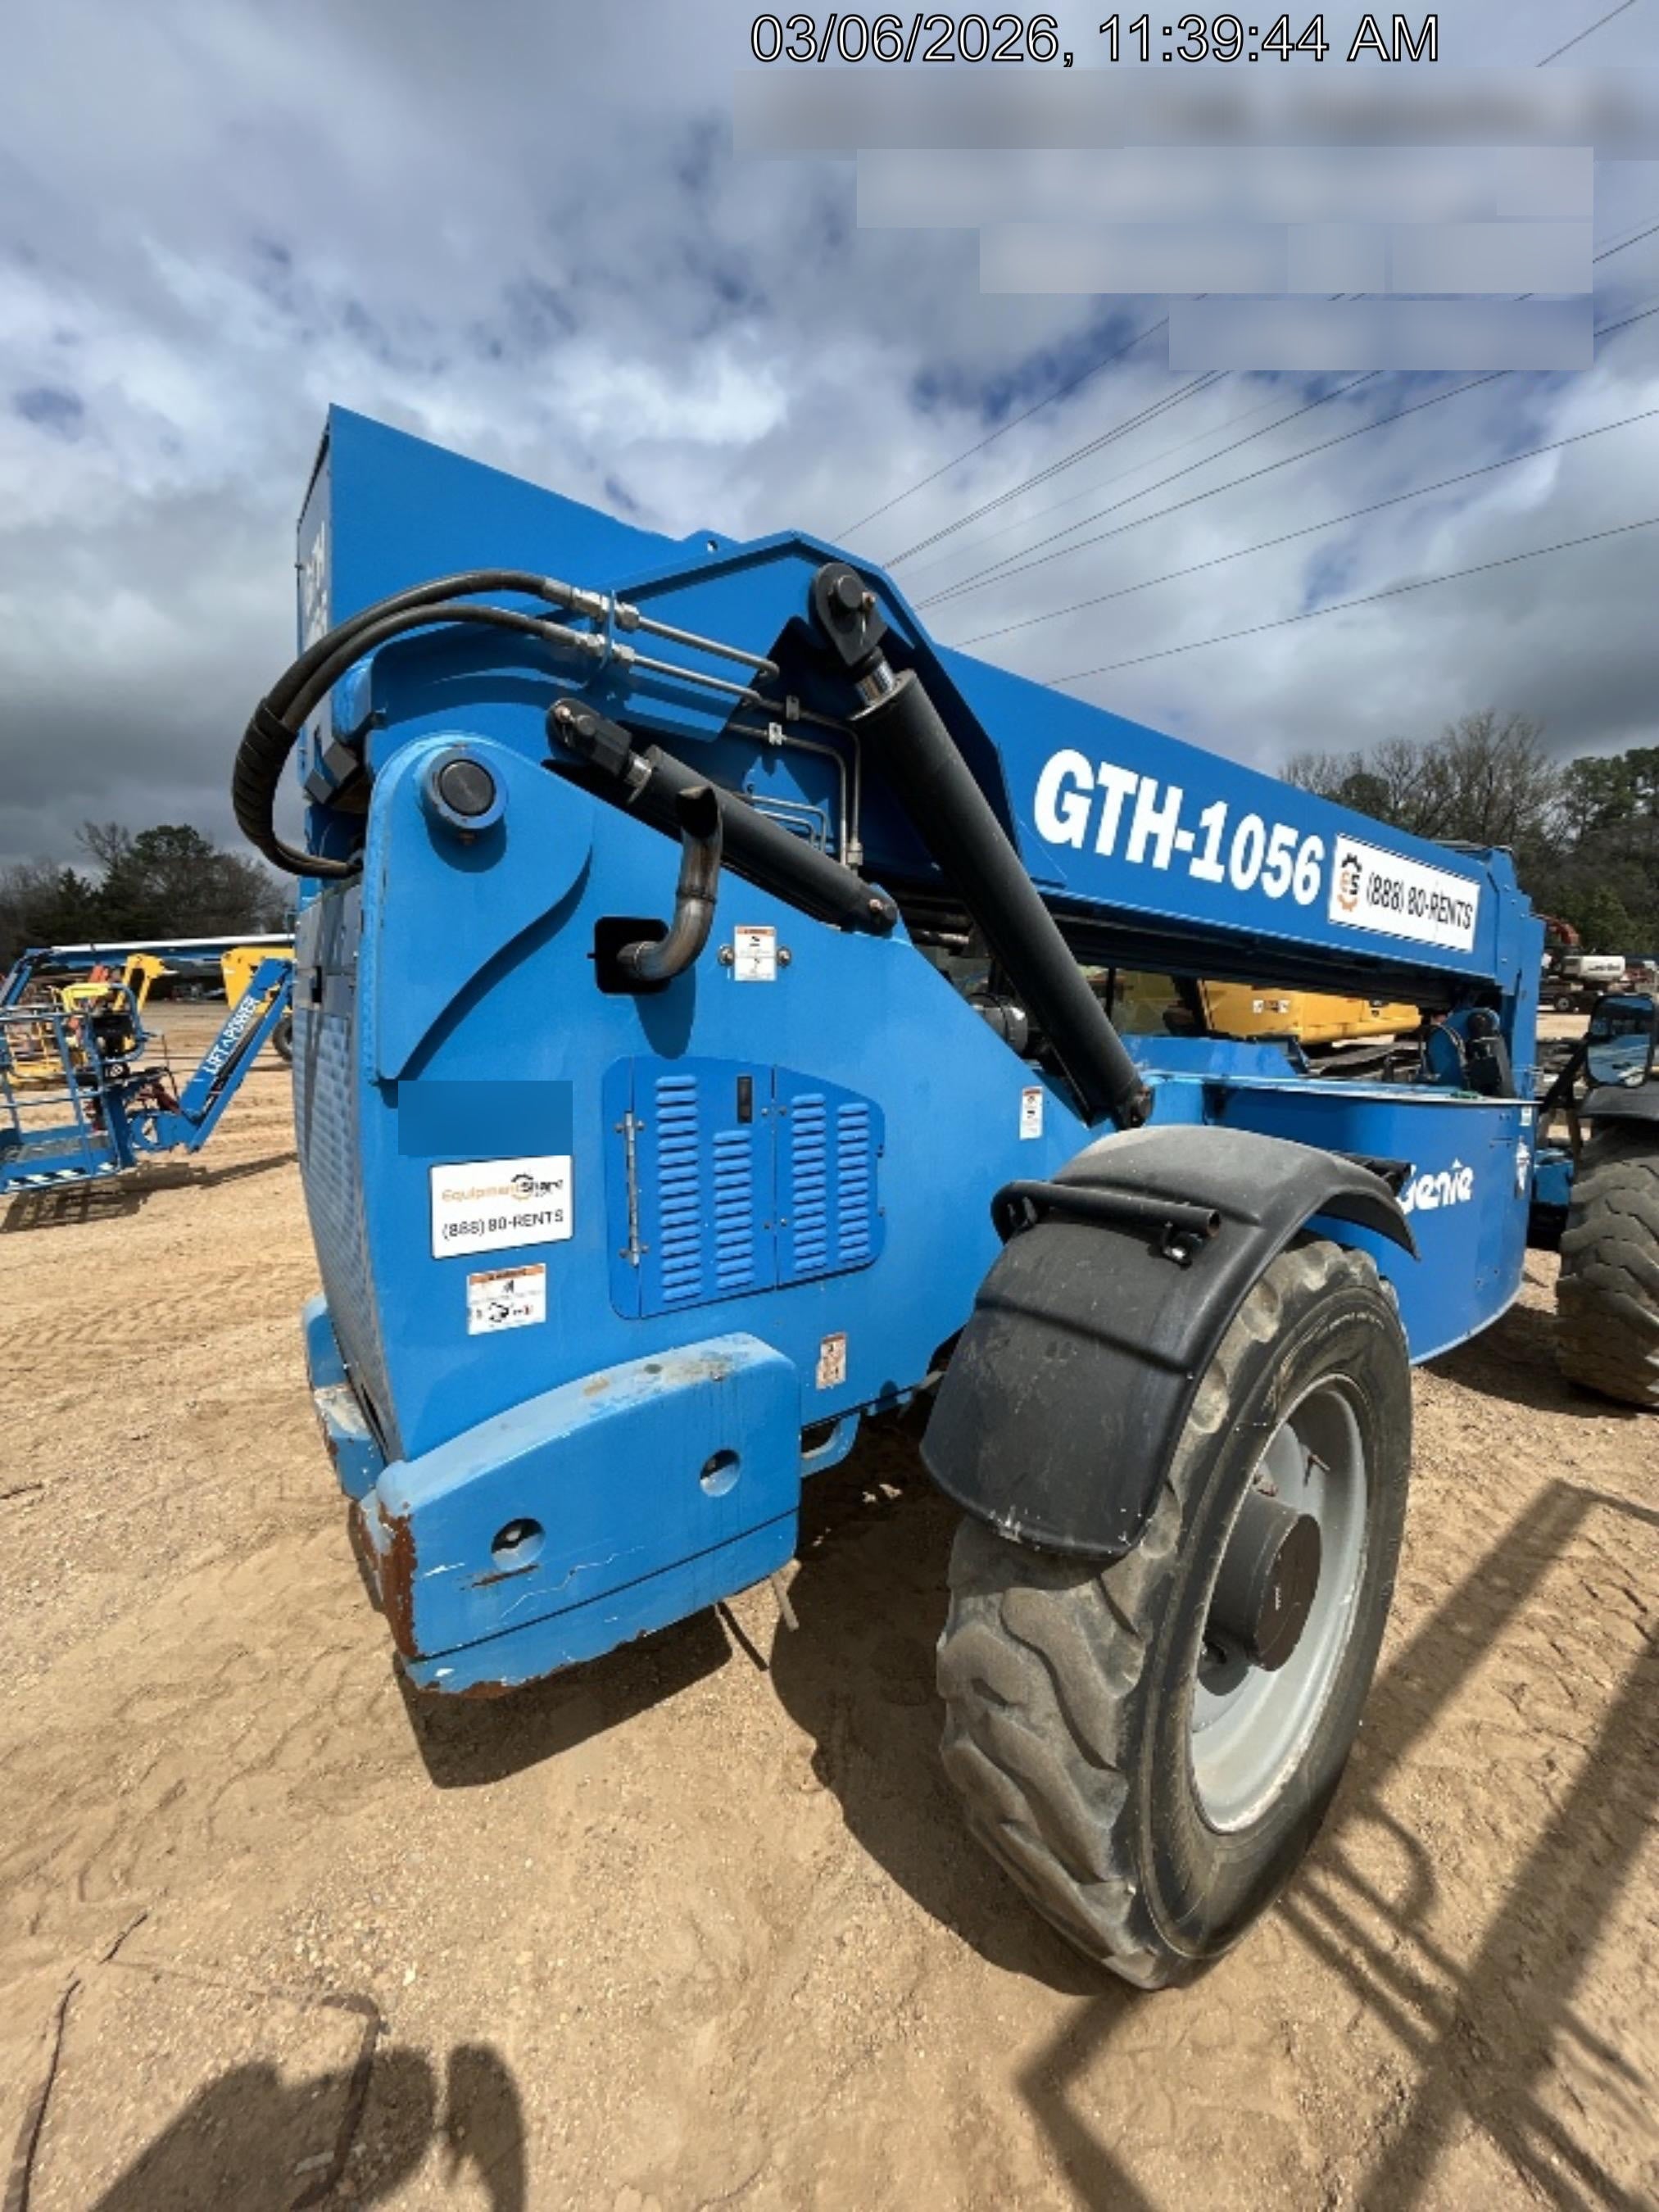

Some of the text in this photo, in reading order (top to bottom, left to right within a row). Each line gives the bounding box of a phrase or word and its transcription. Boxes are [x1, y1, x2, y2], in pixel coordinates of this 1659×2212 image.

[1034, 749, 1325, 906] GTH-1056
[1367, 872, 1473, 929] (888) 80-RENTS
